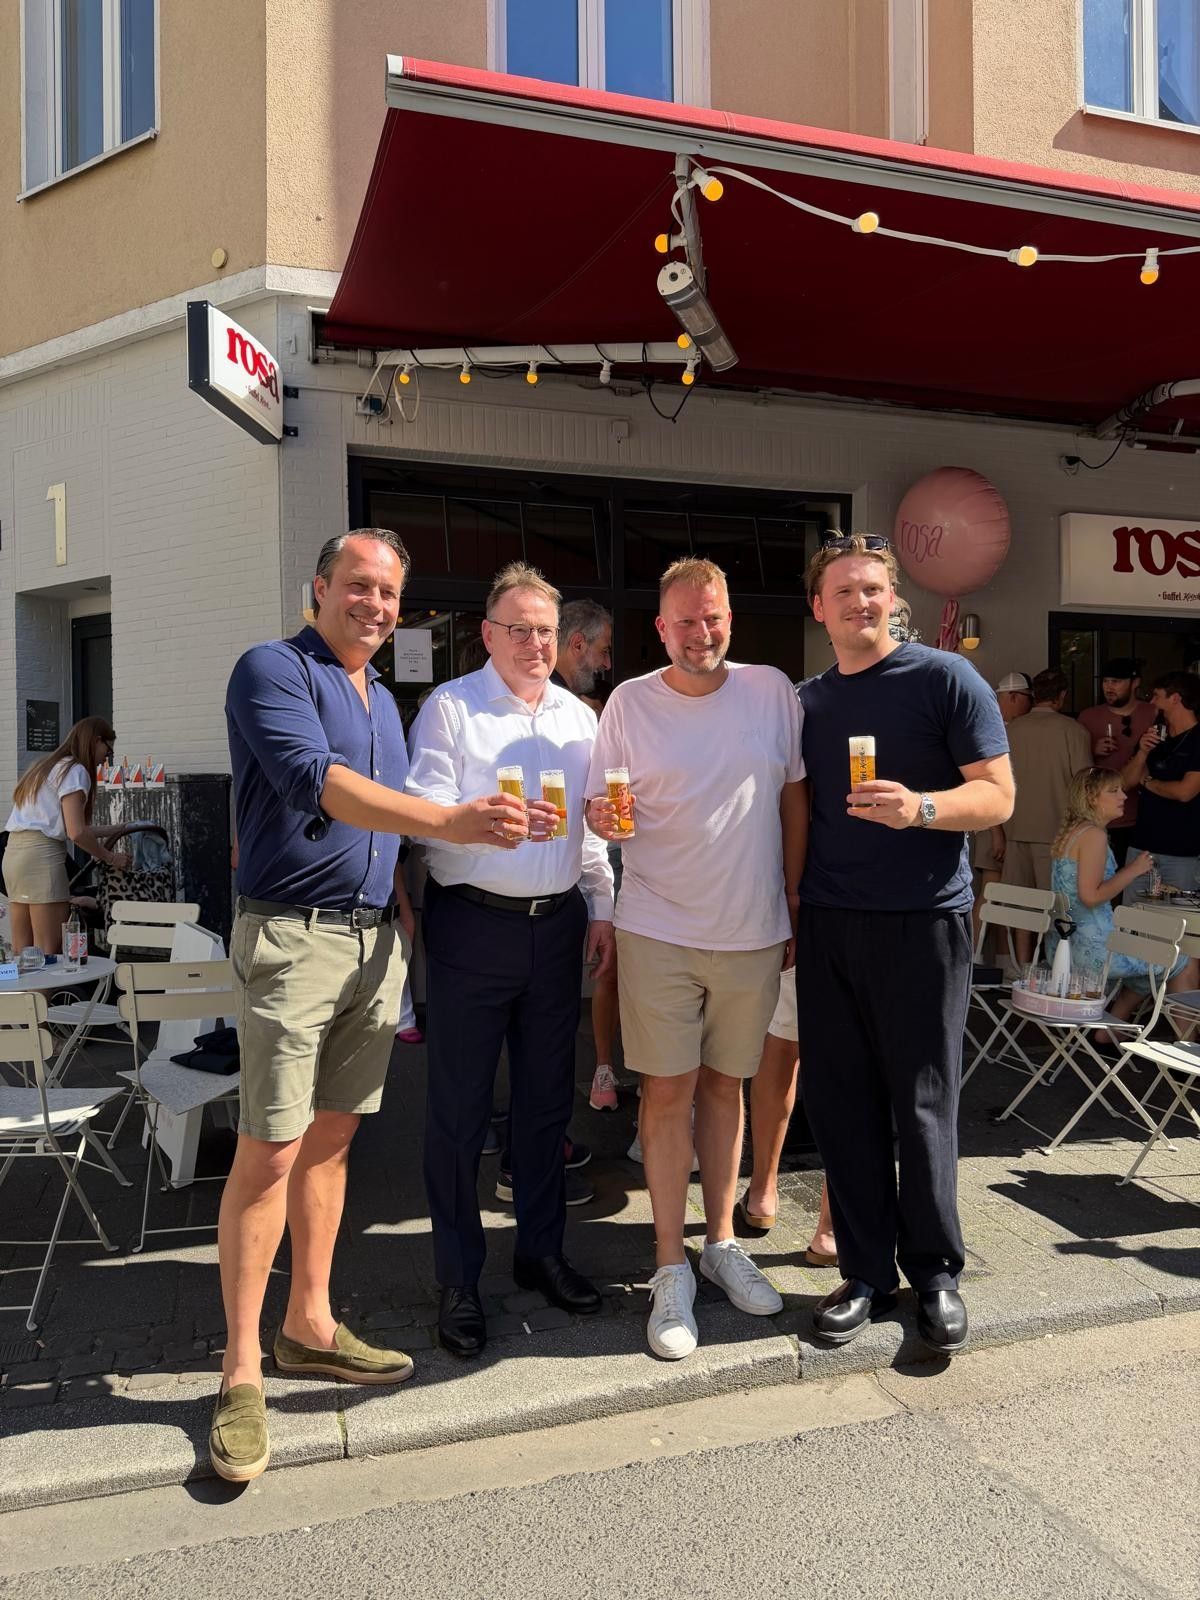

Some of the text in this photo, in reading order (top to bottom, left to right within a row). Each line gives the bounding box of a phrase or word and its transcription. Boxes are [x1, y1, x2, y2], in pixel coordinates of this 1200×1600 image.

[227, 328, 279, 404] rosa
[46, 482, 66, 566] 1
[901, 520, 943, 563] rosa
